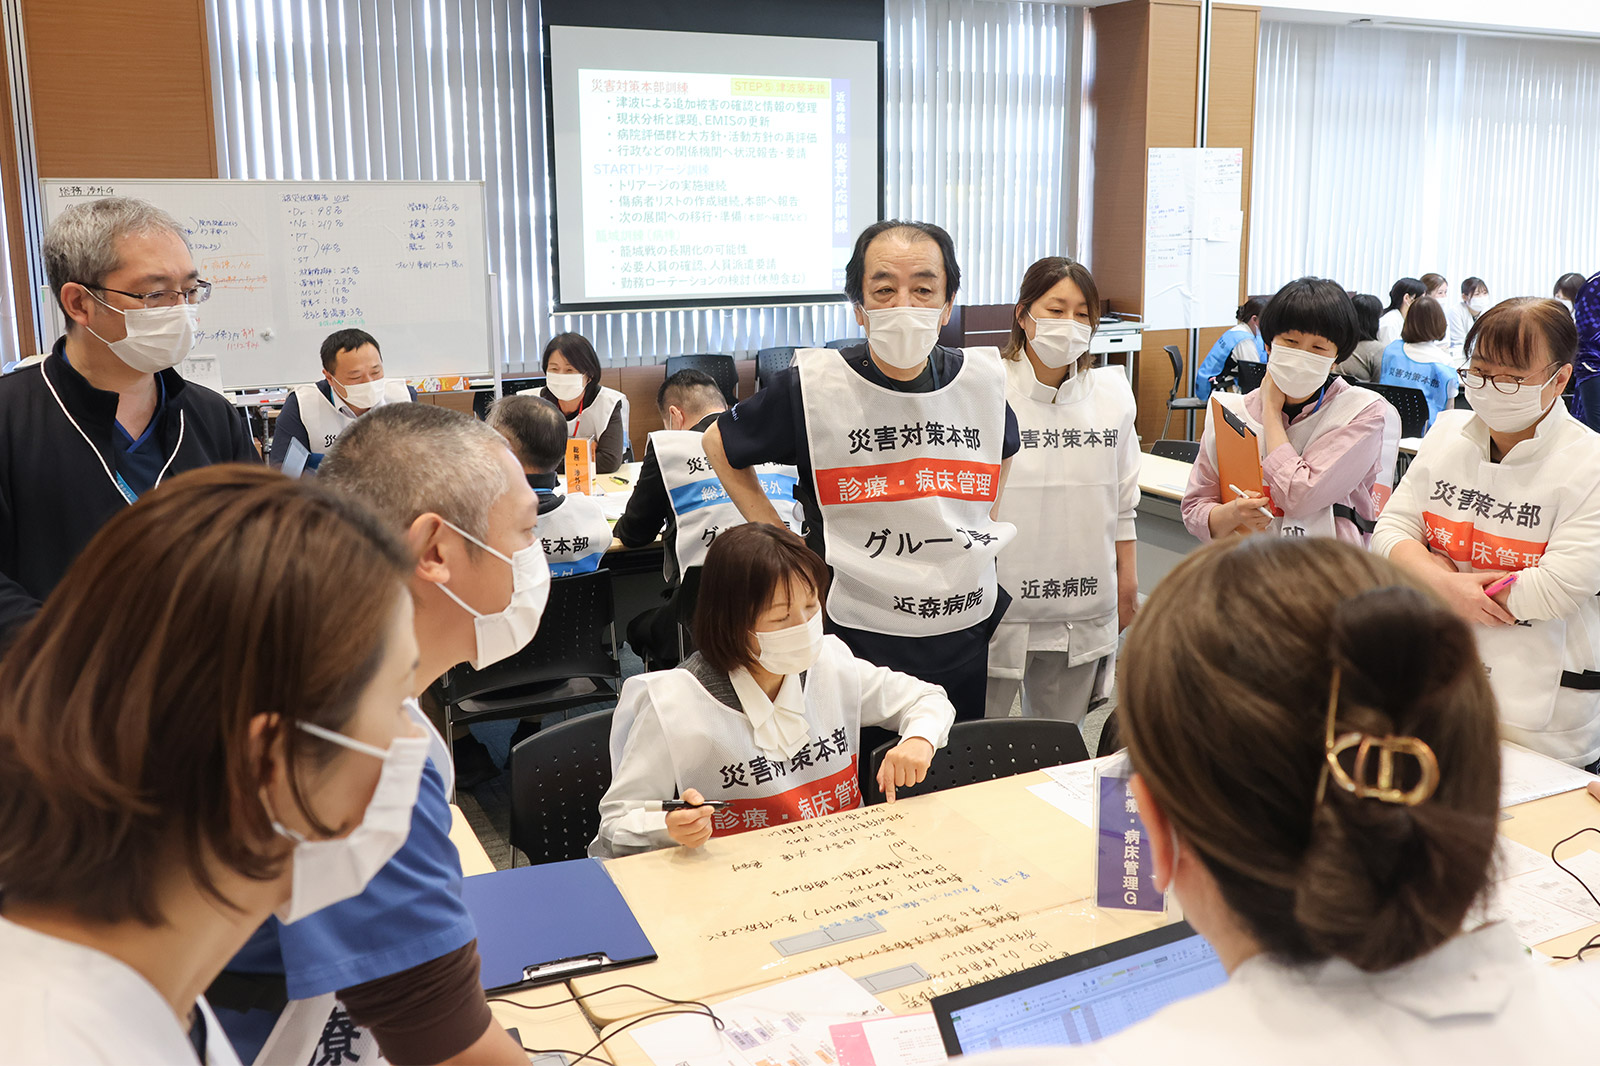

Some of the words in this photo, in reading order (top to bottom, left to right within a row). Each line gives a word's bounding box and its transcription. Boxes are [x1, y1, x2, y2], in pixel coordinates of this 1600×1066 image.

[591, 78, 689, 95] 災害対策本部訓練
[616, 96, 818, 114] 津波による追加被害の確認と情報の整理
[616, 144, 807, 160] 行政などの関係機関へ状況報告・要請
[593, 163, 709, 177] STARTトリアージ訓練
[618, 179, 728, 192] トリアージの実施継続
[834, 142, 849, 233] 災害対応訓練
[848, 421, 981, 455] 災害対策本部
[837, 466, 992, 503] 診療・病床管理
[1021, 577, 1098, 600] 近森病院
[893, 587, 984, 619] 近森病院
